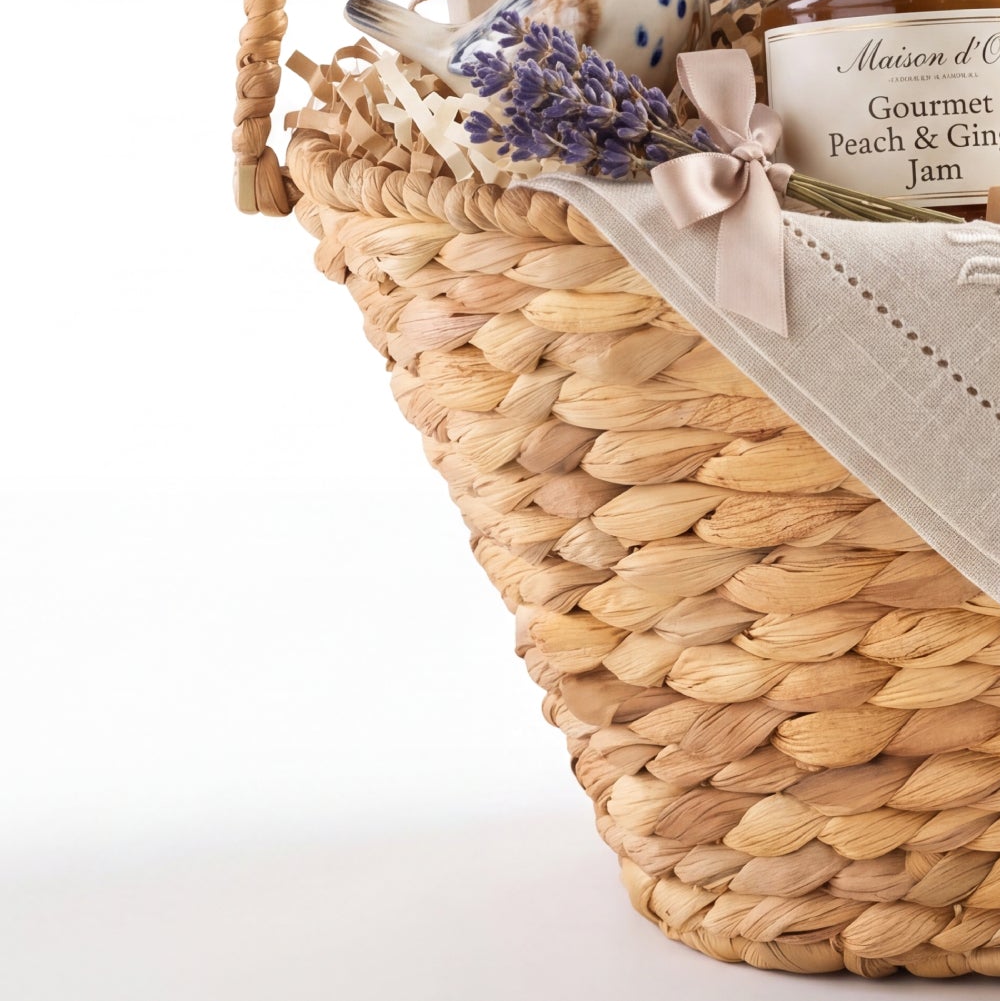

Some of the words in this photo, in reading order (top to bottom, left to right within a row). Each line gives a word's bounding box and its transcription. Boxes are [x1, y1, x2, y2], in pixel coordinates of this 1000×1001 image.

[836, 38, 948, 74] Maison
[868, 94, 994, 120] Gourmet
[828, 127, 906, 158] Peach
[914, 126, 939, 150] &
[905, 158, 964, 190] Jam
